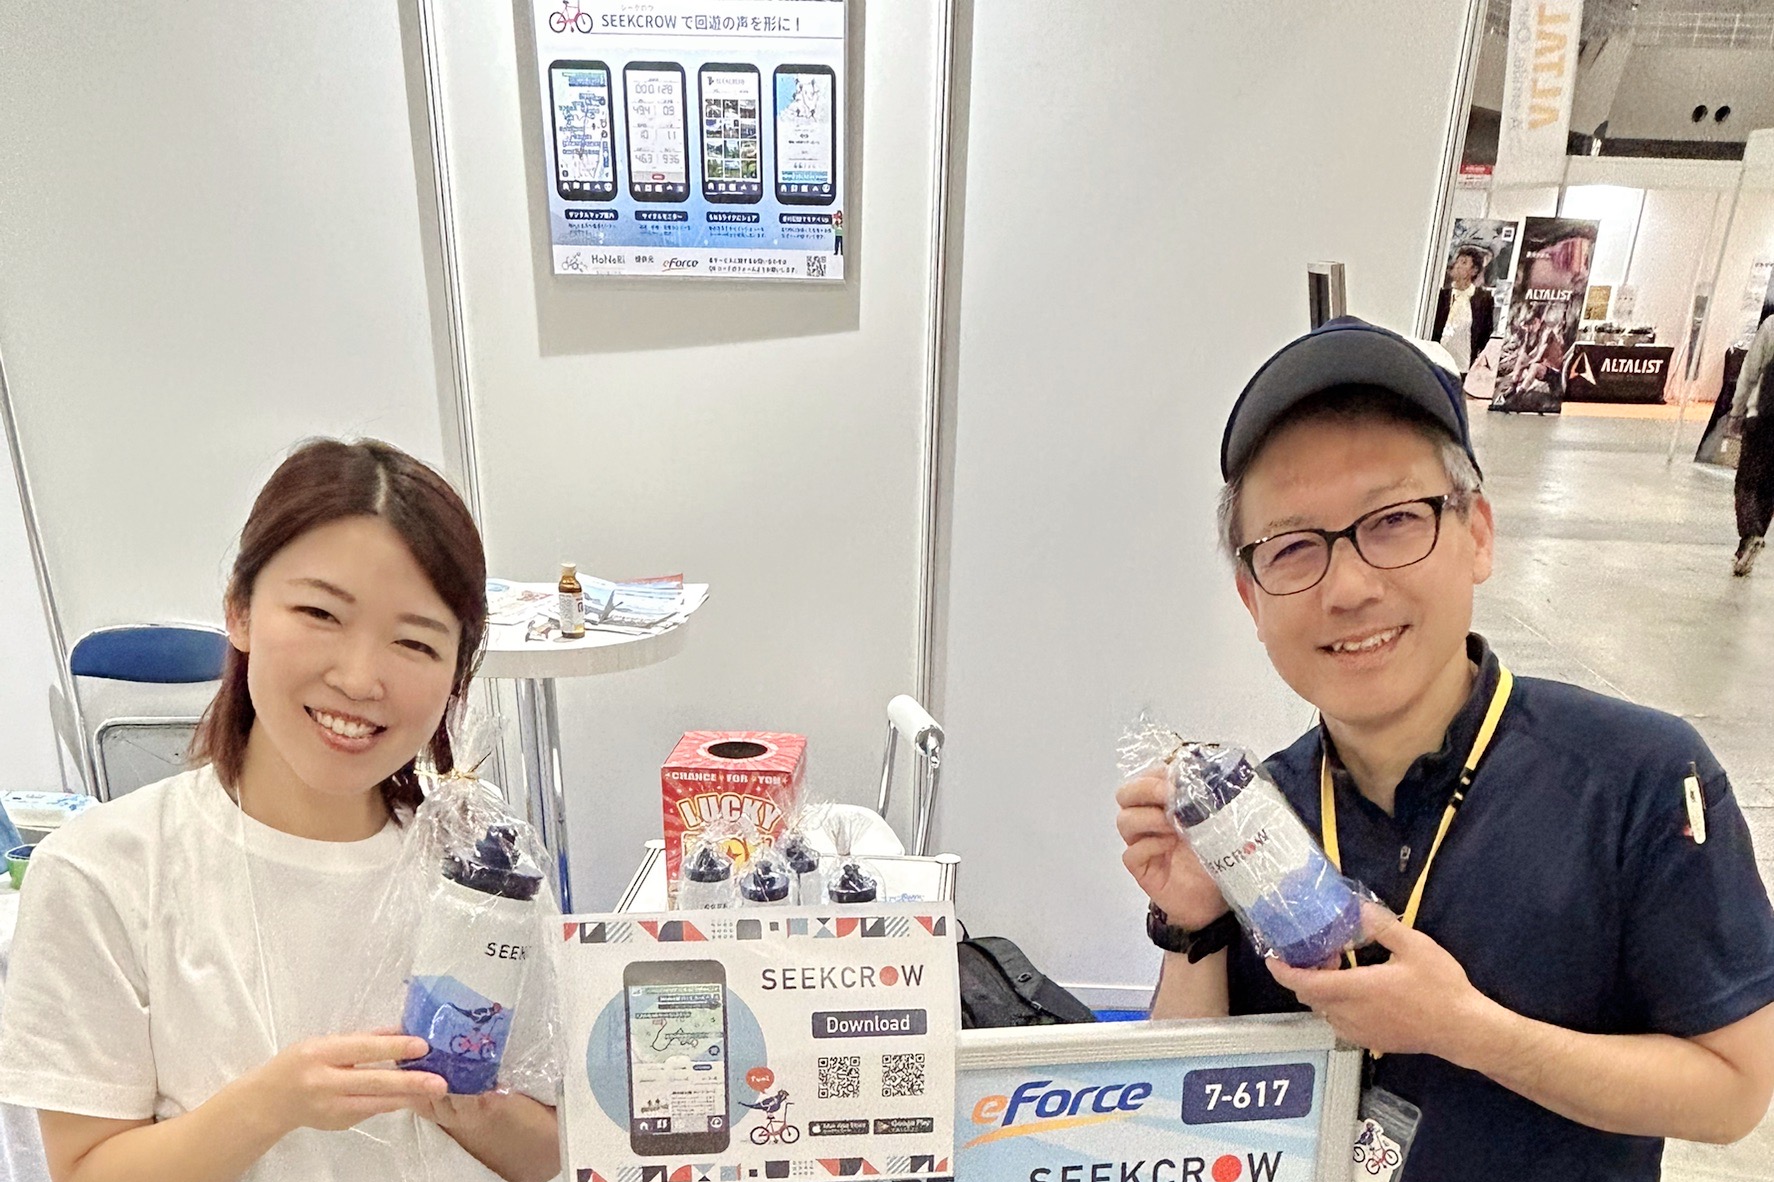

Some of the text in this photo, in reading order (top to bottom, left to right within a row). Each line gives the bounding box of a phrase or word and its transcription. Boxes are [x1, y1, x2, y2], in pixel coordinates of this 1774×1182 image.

[602, 14, 676, 29] SEEKCROW
[1525, 288, 1573, 301] ALTALIST
[1600, 358, 1664, 374] ALTALIST
[671, 772, 781, 784] CHANCE FOR YOU
[677, 793, 783, 832] LUCKY
[761, 965, 924, 990] SEEKCROW
[826, 1015, 910, 1034] Download
[970, 1080, 1153, 1127] eForce
[1204, 1080, 1290, 1111] 7-617
